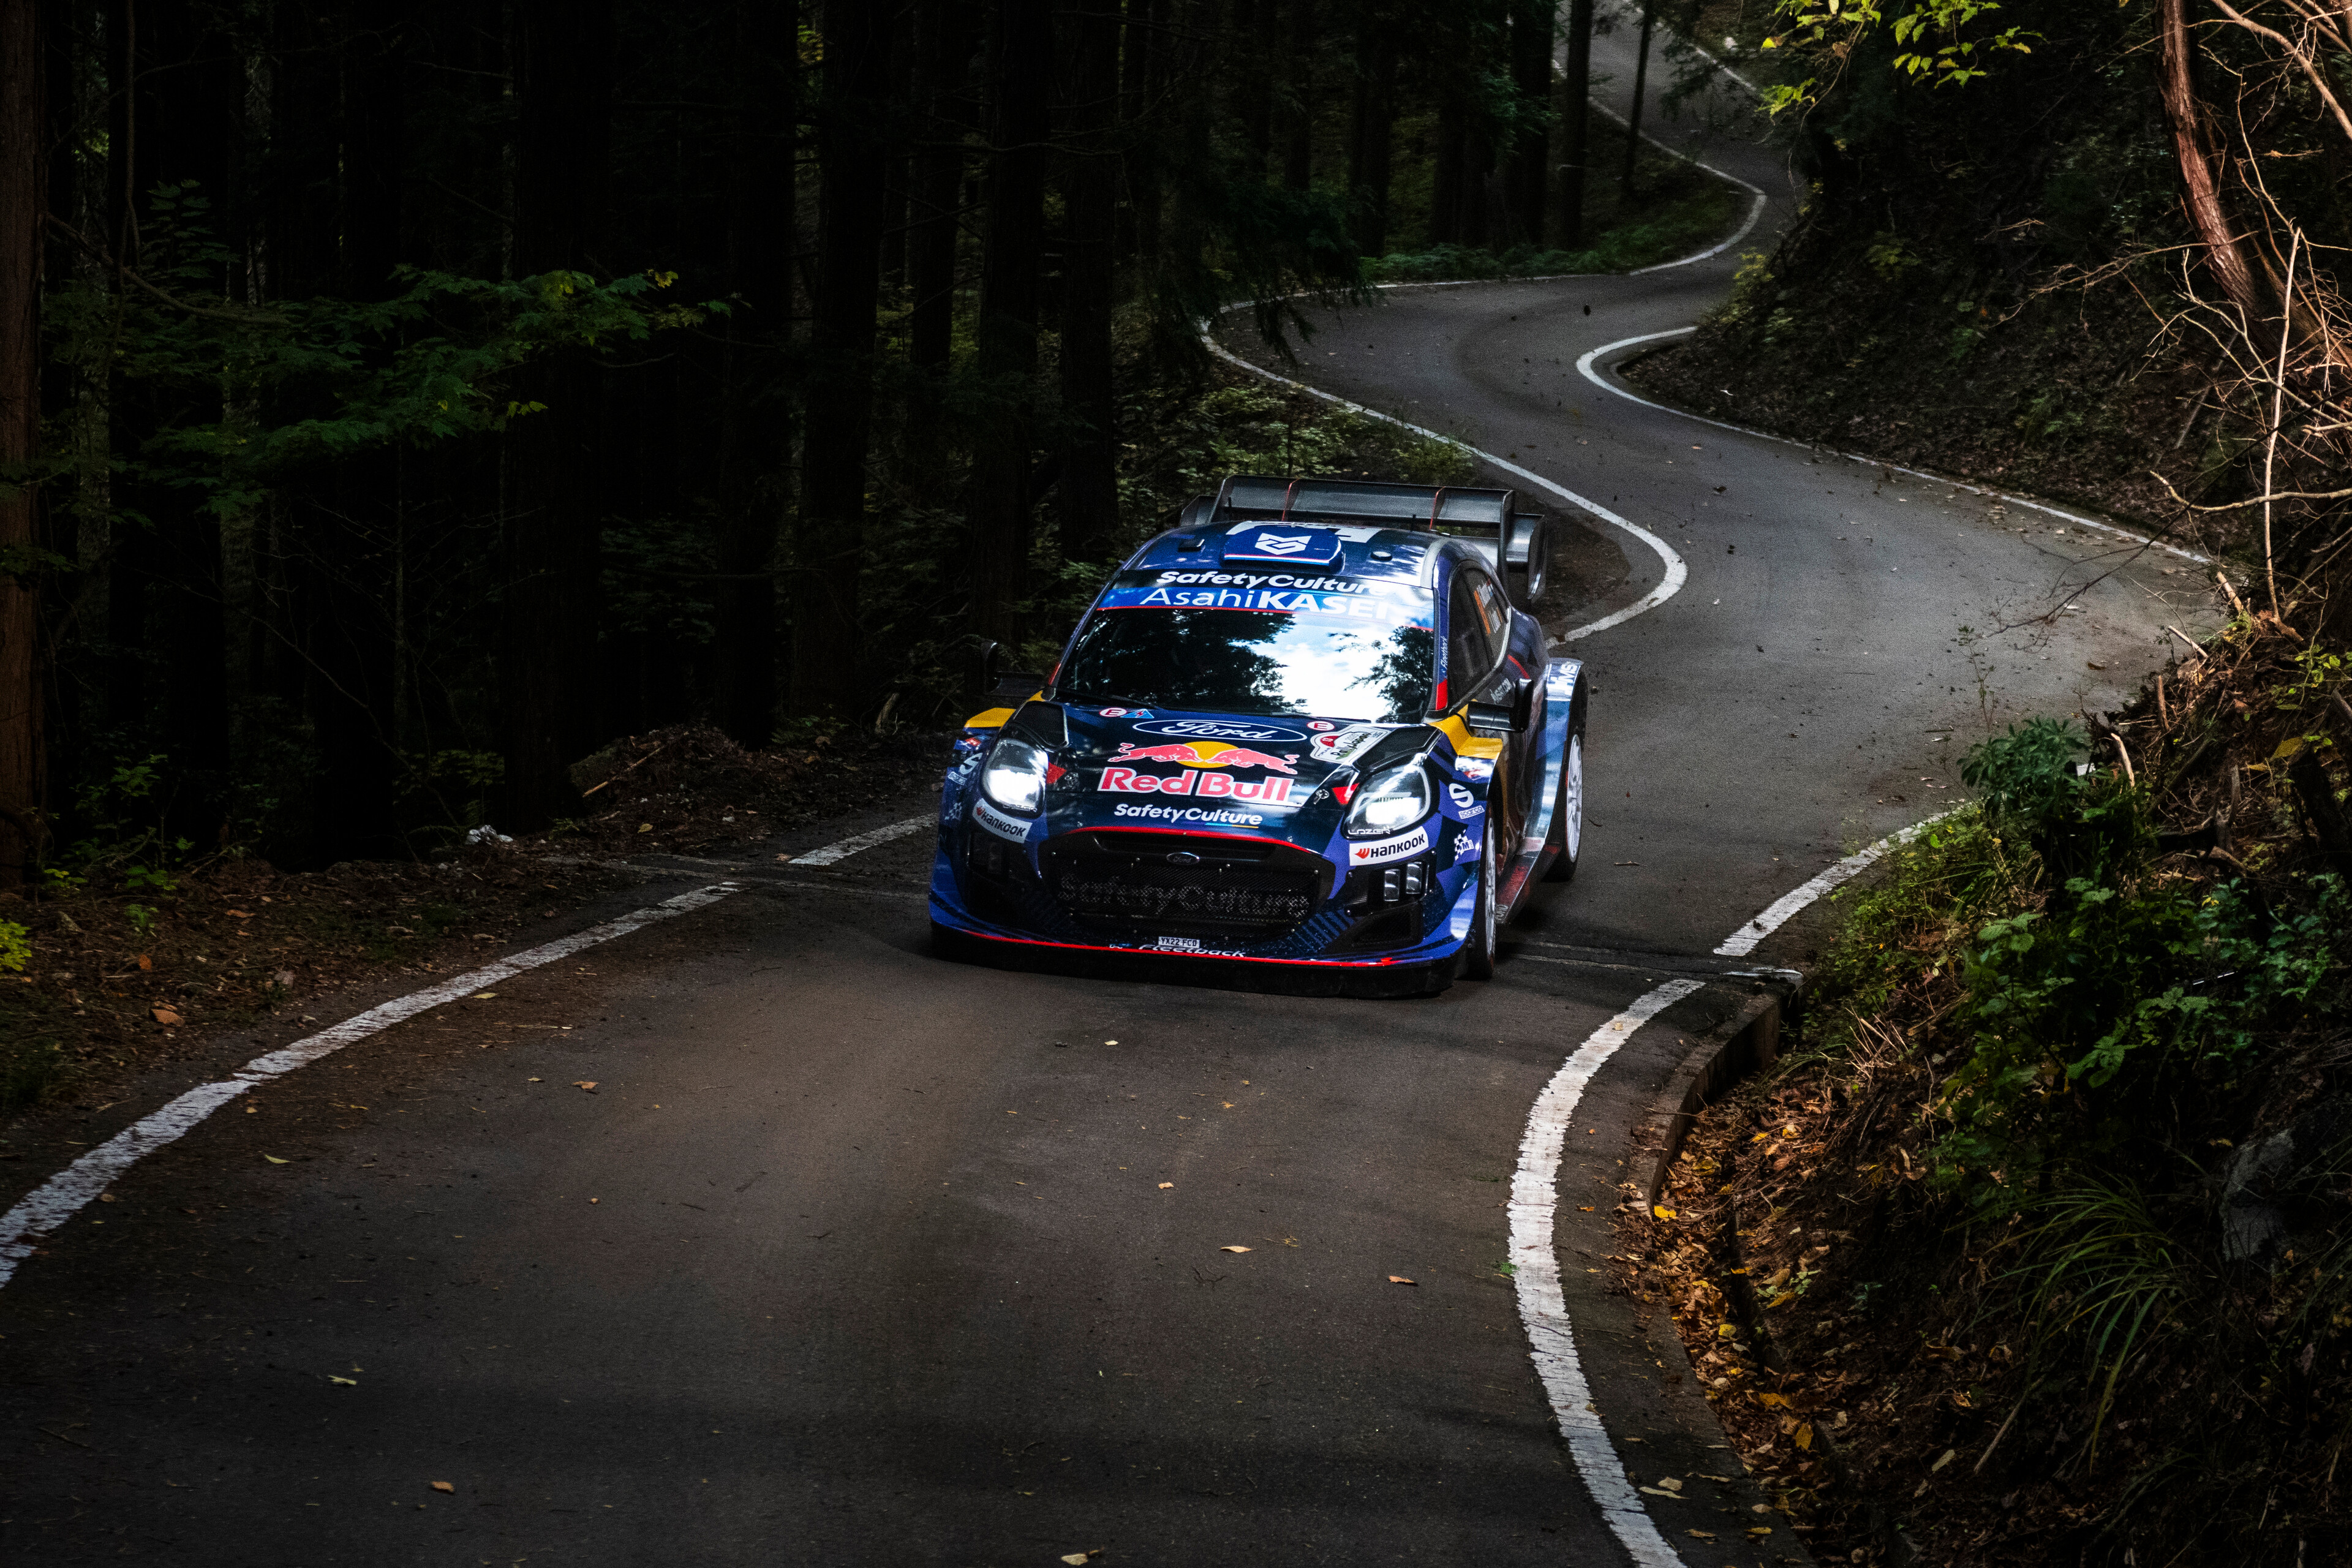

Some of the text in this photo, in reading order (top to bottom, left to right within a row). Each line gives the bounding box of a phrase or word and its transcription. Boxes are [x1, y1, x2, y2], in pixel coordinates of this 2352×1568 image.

[1162, 722, 1278, 739] Ford
[1098, 767, 1294, 804] Red Bull
[1114, 804, 1262, 824] SafetyCulture
[1460, 807, 1483, 818] sparco
